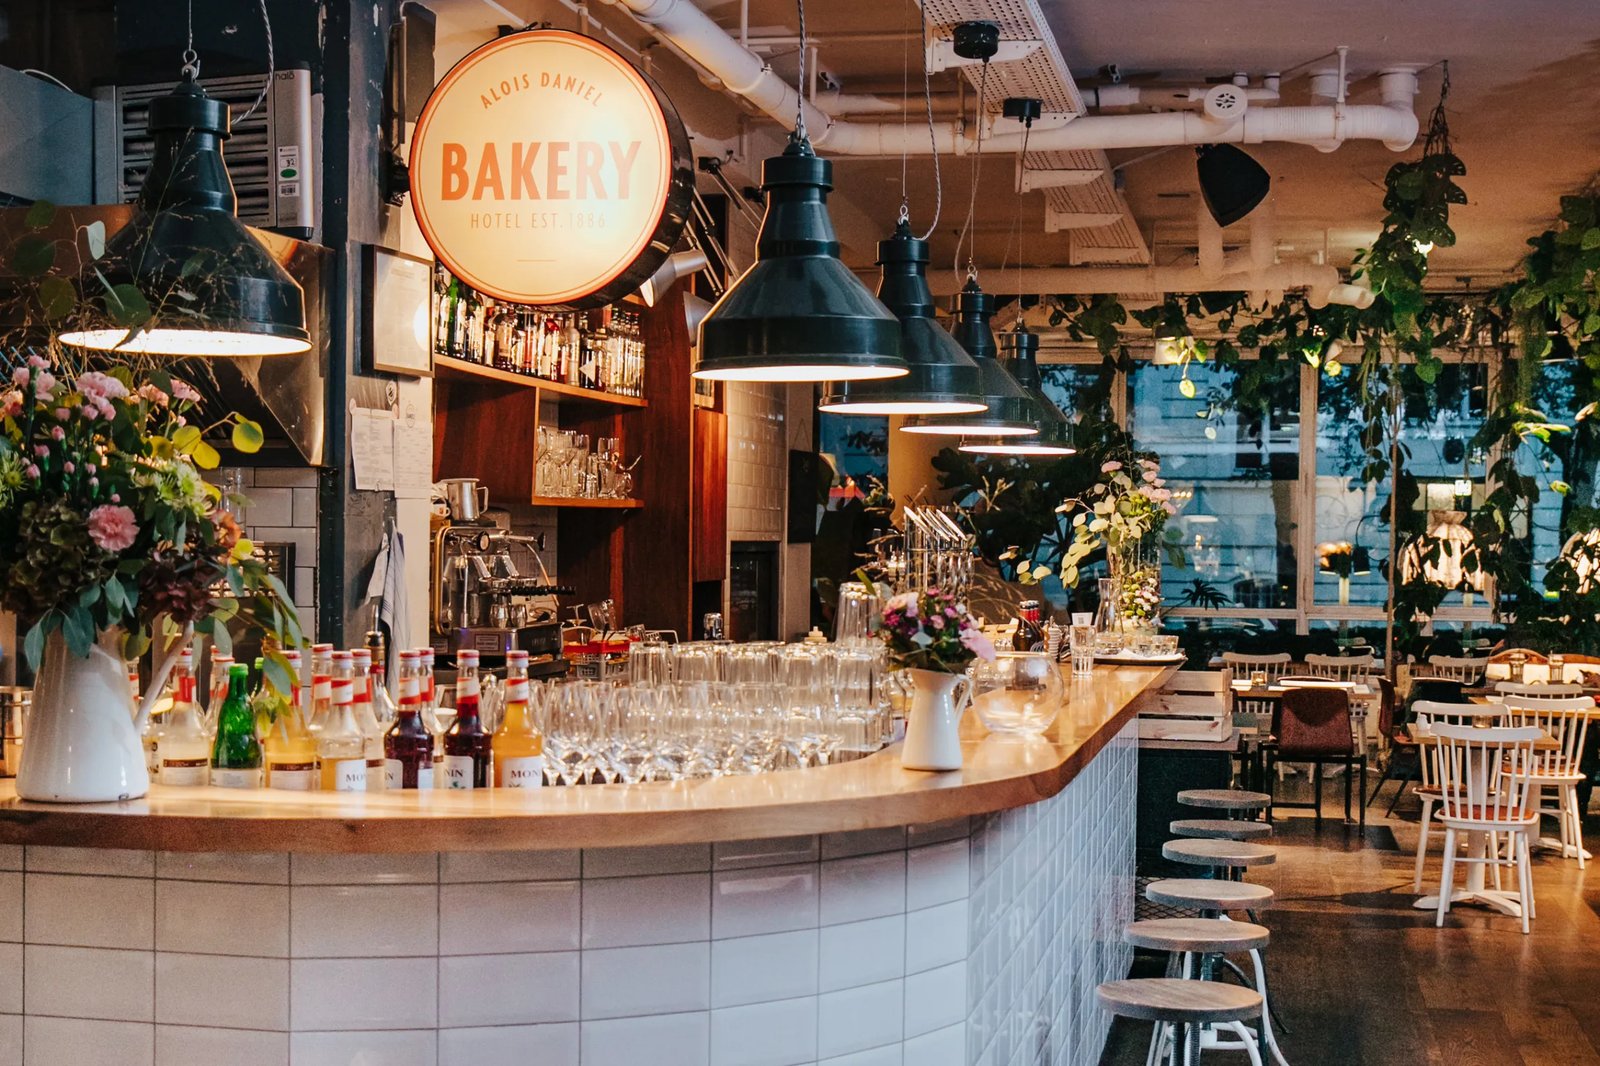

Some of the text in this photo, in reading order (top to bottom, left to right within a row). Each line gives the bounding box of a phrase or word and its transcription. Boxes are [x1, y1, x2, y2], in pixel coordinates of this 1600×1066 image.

[481, 72, 602, 109] ALOIS DANIEL
[441, 141, 642, 200] BAKERY
[471, 213, 521, 229] HOTEL
